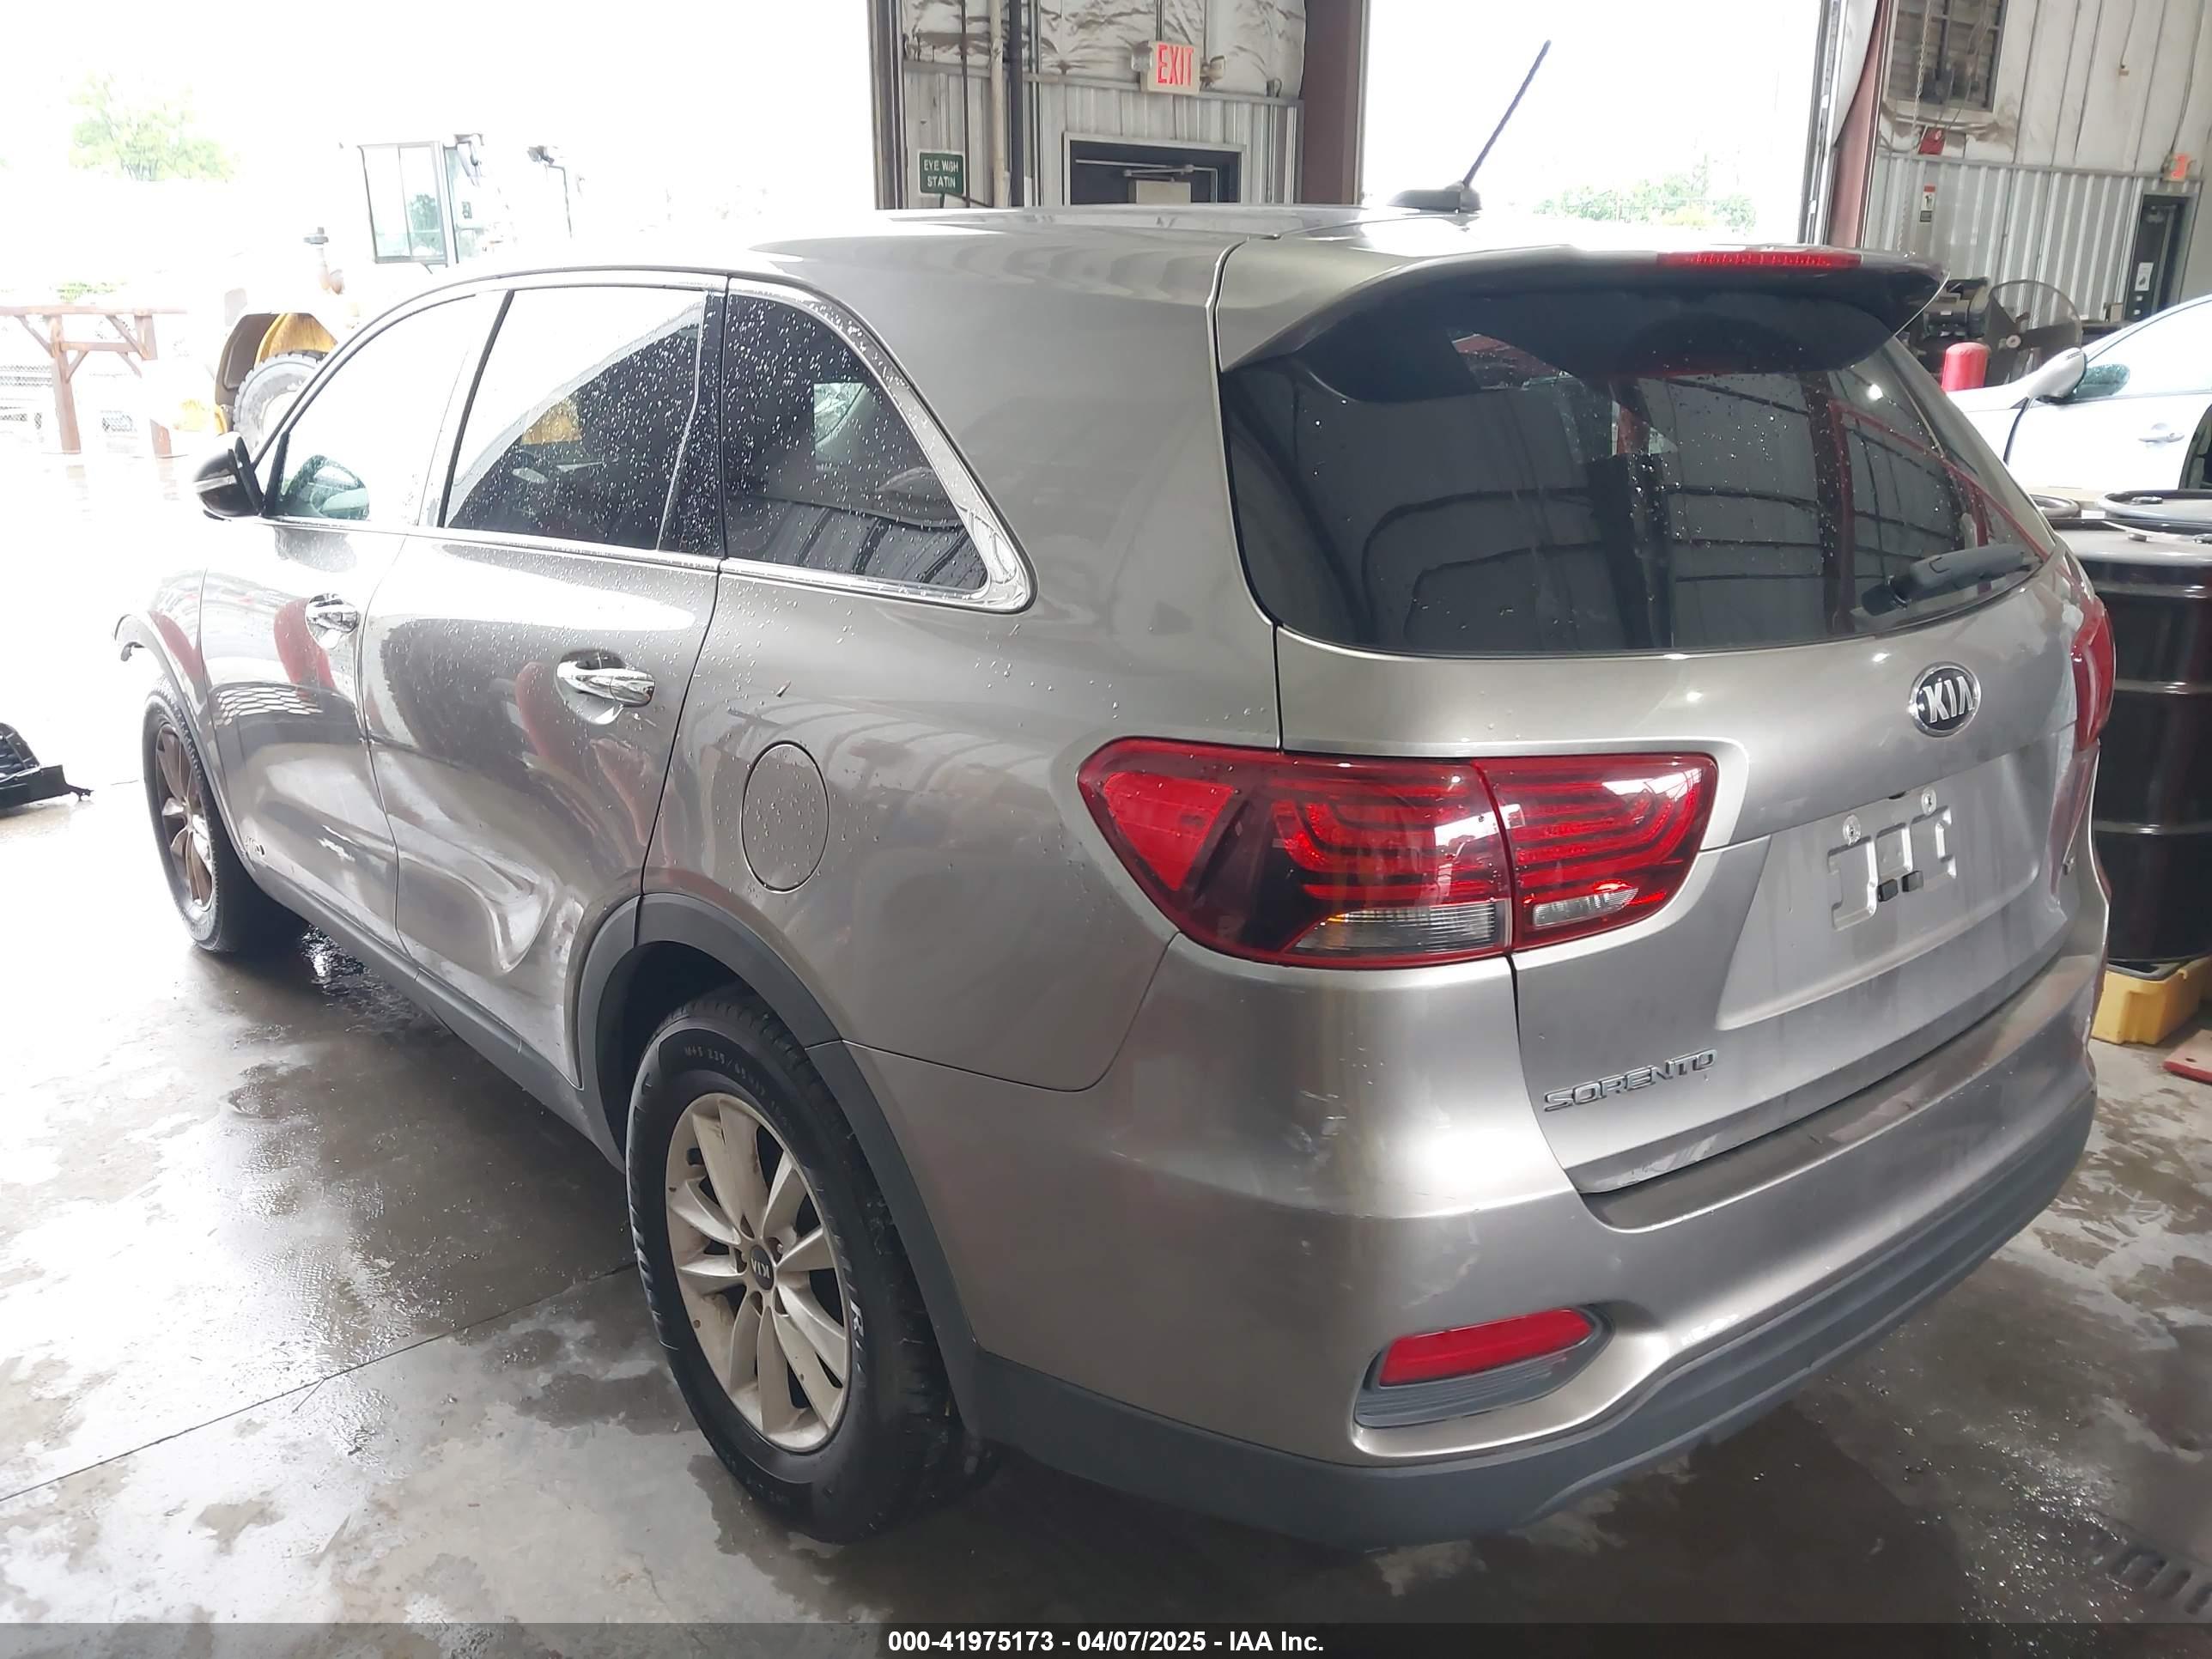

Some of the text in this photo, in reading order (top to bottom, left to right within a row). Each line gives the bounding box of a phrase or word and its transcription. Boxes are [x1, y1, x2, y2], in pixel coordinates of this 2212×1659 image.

[1157, 43, 1194, 87] EXIT
[923, 158, 939, 172] EYE
[1923, 676, 1975, 724] KIA
[1544, 1048, 1718, 1112] SORENTO
[750, 1256, 770, 1279] KIA
